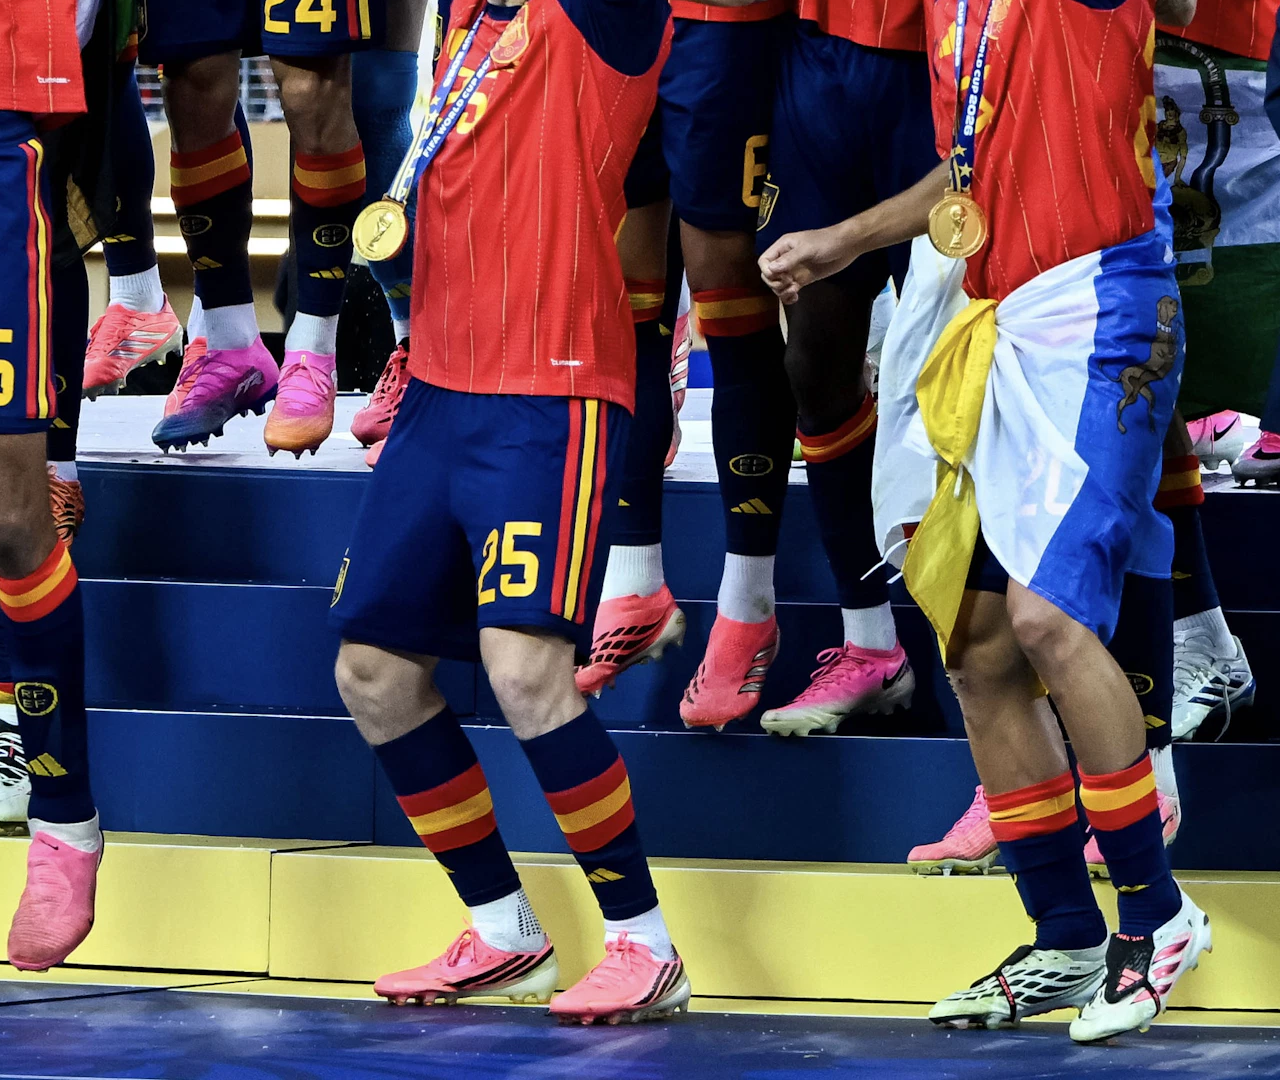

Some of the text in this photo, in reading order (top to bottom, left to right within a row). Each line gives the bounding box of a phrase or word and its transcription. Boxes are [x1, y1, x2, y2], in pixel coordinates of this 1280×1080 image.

[422, 56, 491, 158] FIFA WORLD CUP 20
[963, 28, 988, 135] WORLD CUP 2026
[477, 522, 543, 606] 25
